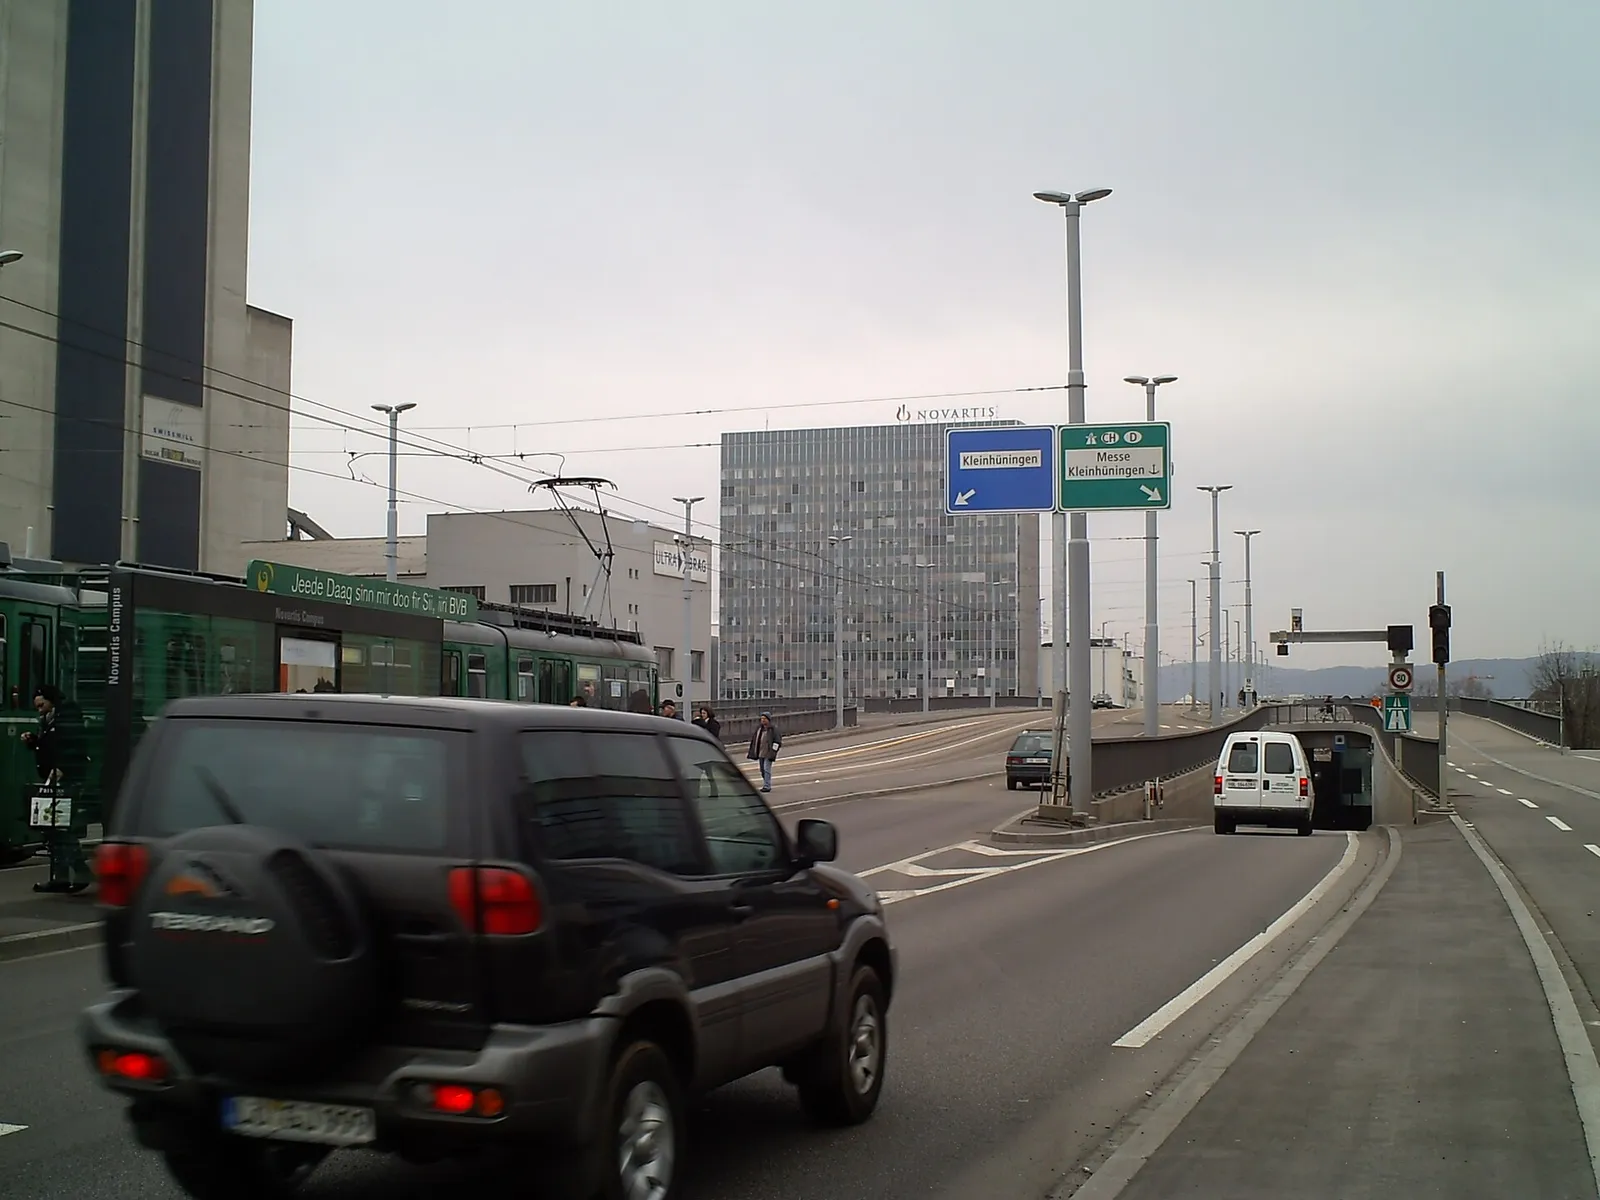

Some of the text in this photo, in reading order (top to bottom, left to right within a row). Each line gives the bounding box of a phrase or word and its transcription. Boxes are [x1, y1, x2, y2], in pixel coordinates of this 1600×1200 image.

[918, 406, 995, 420] NOVARTIS
[1102, 432, 1137, 443] CH D
[962, 454, 1038, 467] Kleinhüningen
[1096, 451, 1131, 462] Messe
[1068, 465, 1145, 478] Kleinhüningen
[655, 549, 678, 568] ULTRA
[291, 573, 324, 596] Jeede
[326, 577, 353, 606] Daag
[355, 584, 374, 603] sinn
[376, 587, 391, 606] mir
[392, 589, 410, 608] doo
[449, 596, 467, 616] BVB
[108, 587, 124, 685] Novartis Campus
